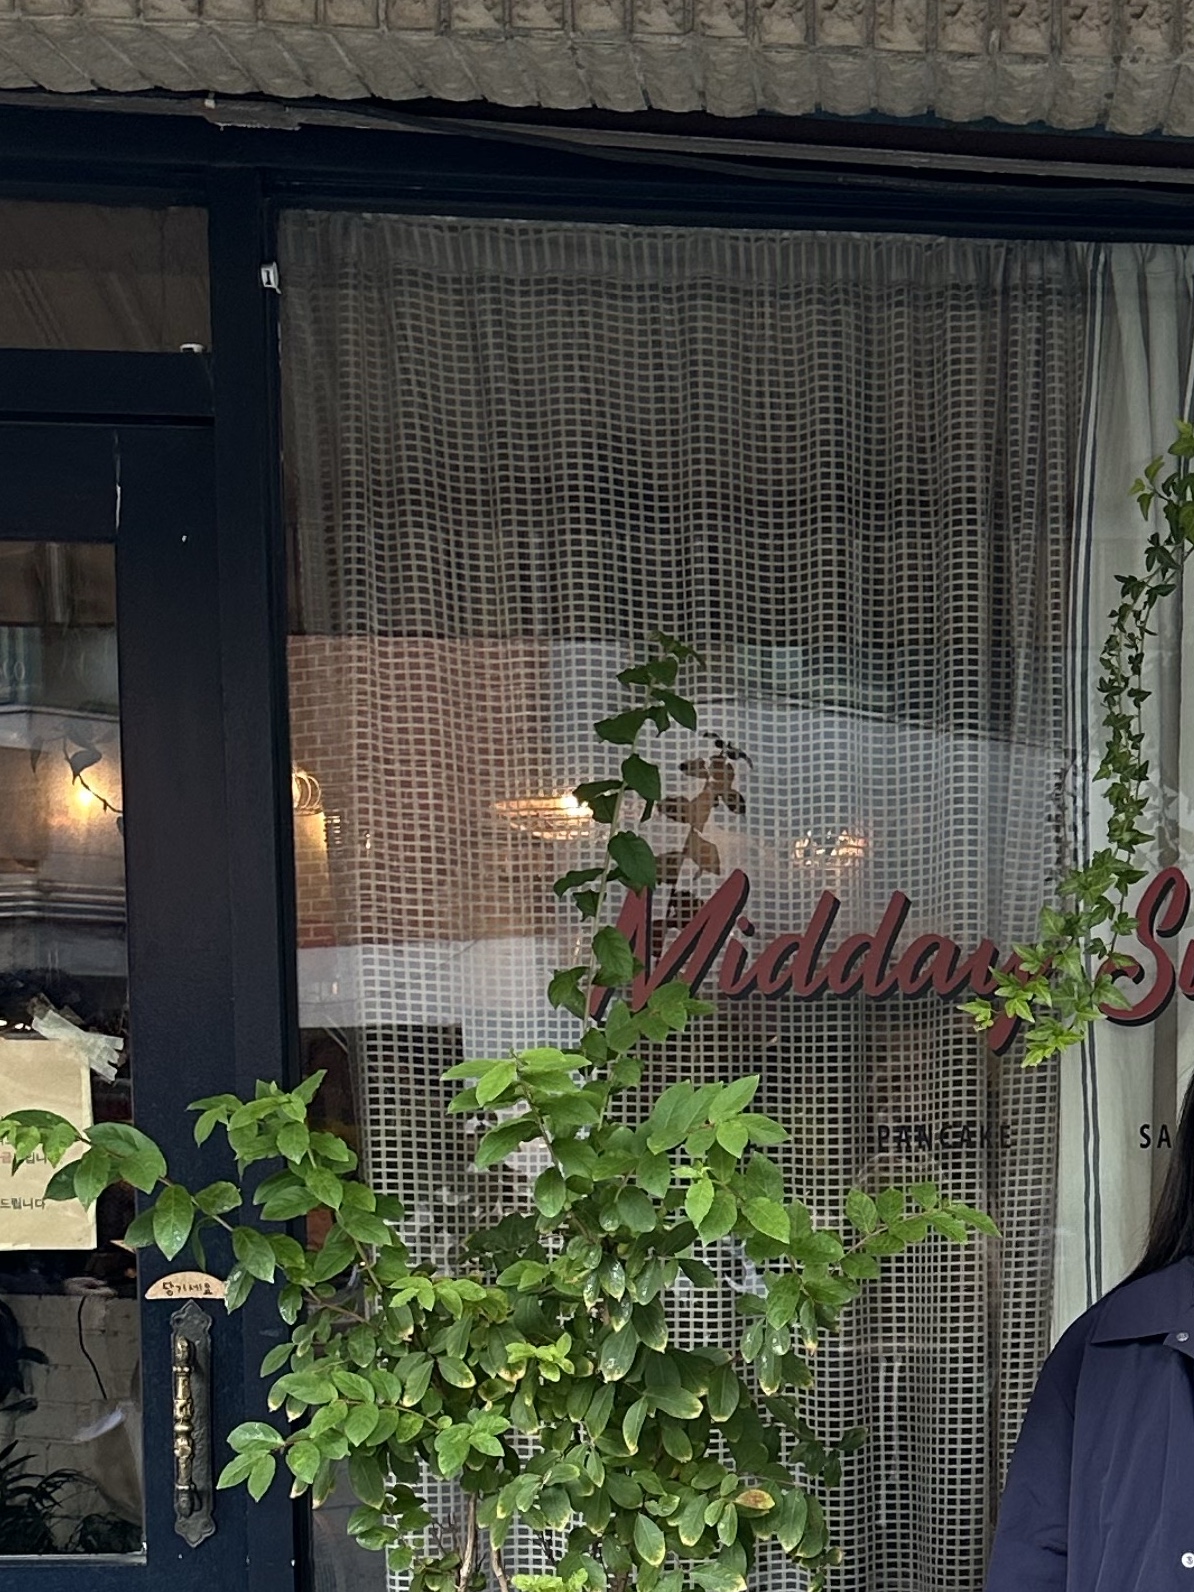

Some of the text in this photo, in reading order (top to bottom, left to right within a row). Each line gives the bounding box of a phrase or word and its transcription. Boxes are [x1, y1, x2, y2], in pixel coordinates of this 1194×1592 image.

[590, 869, 1055, 1056] Midday
[877, 1124, 1174, 1151] PANCAKE SA
[162, 1281, 213, 1297] 당기세요
